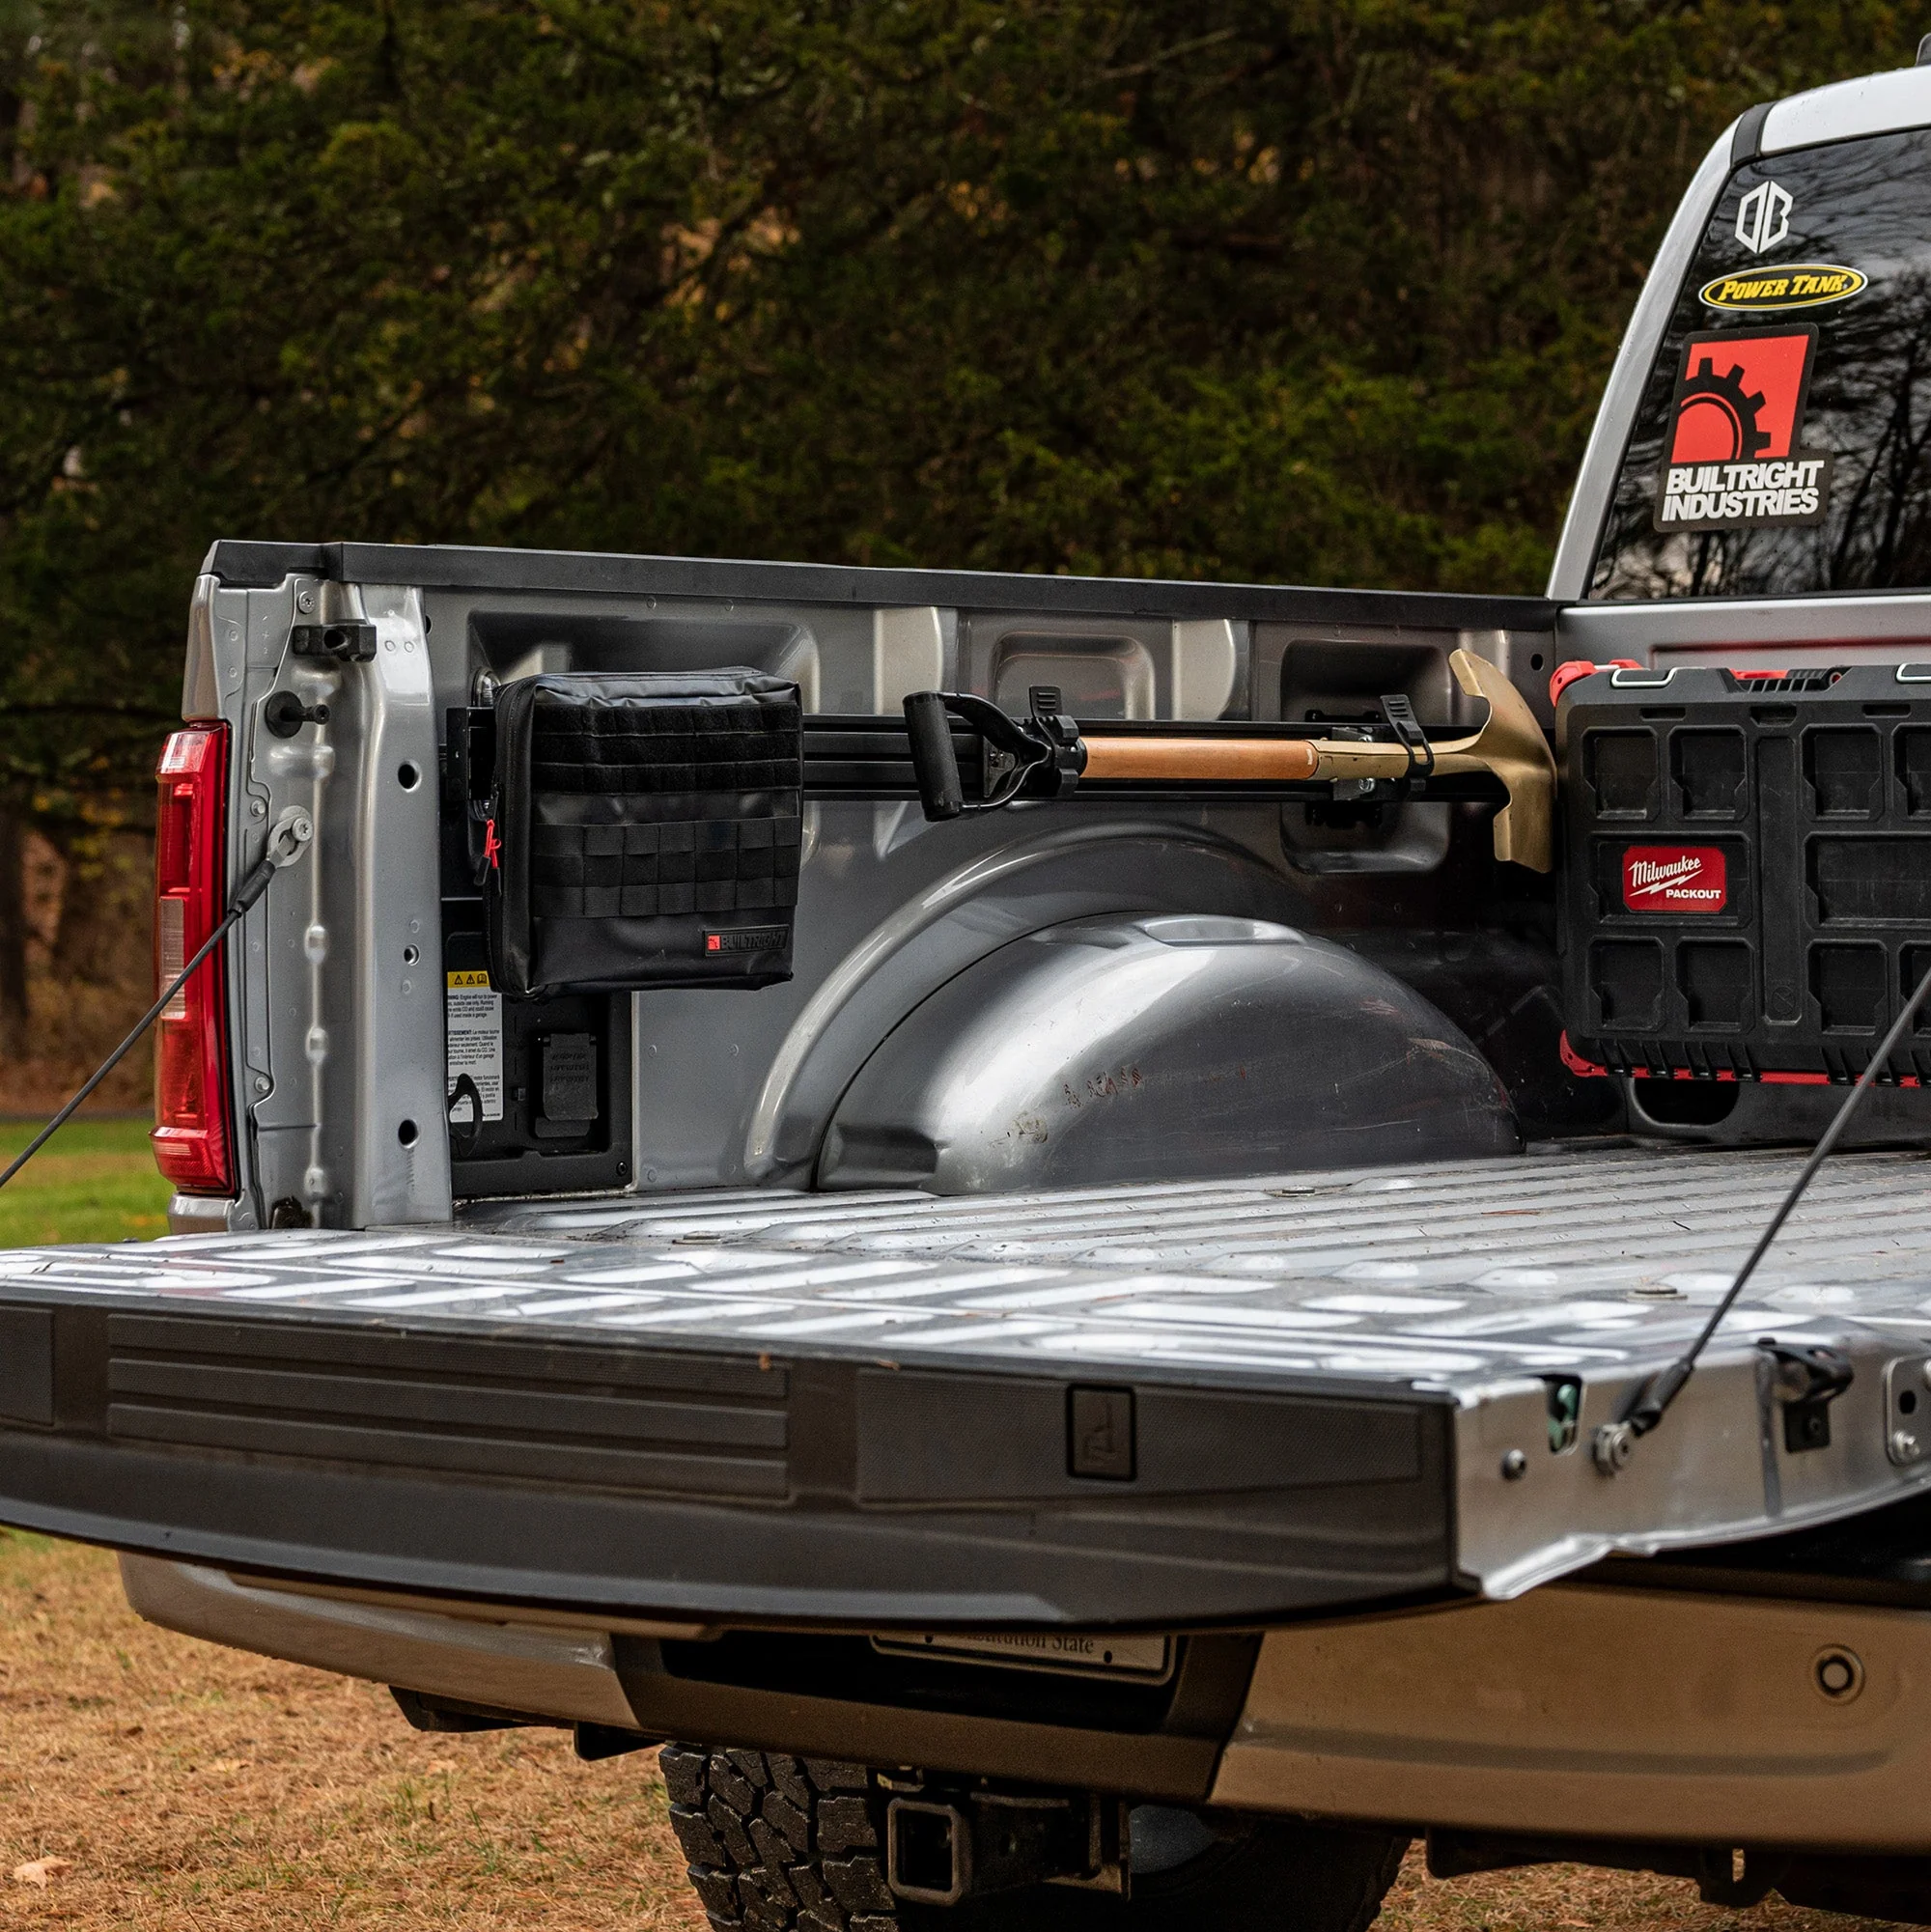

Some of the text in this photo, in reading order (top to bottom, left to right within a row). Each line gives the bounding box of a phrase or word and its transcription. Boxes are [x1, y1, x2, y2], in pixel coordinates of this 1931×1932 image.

[1718, 274, 1848, 301] POWER TANK
[1665, 460, 1825, 494] BUILTRIGHT
[1662, 488, 1819, 521] INDUSTRIES
[1628, 854, 1702, 887] Milwaukee
[1665, 888, 1721, 899] PACKOUT
[1052, 1635, 1094, 1654] State
